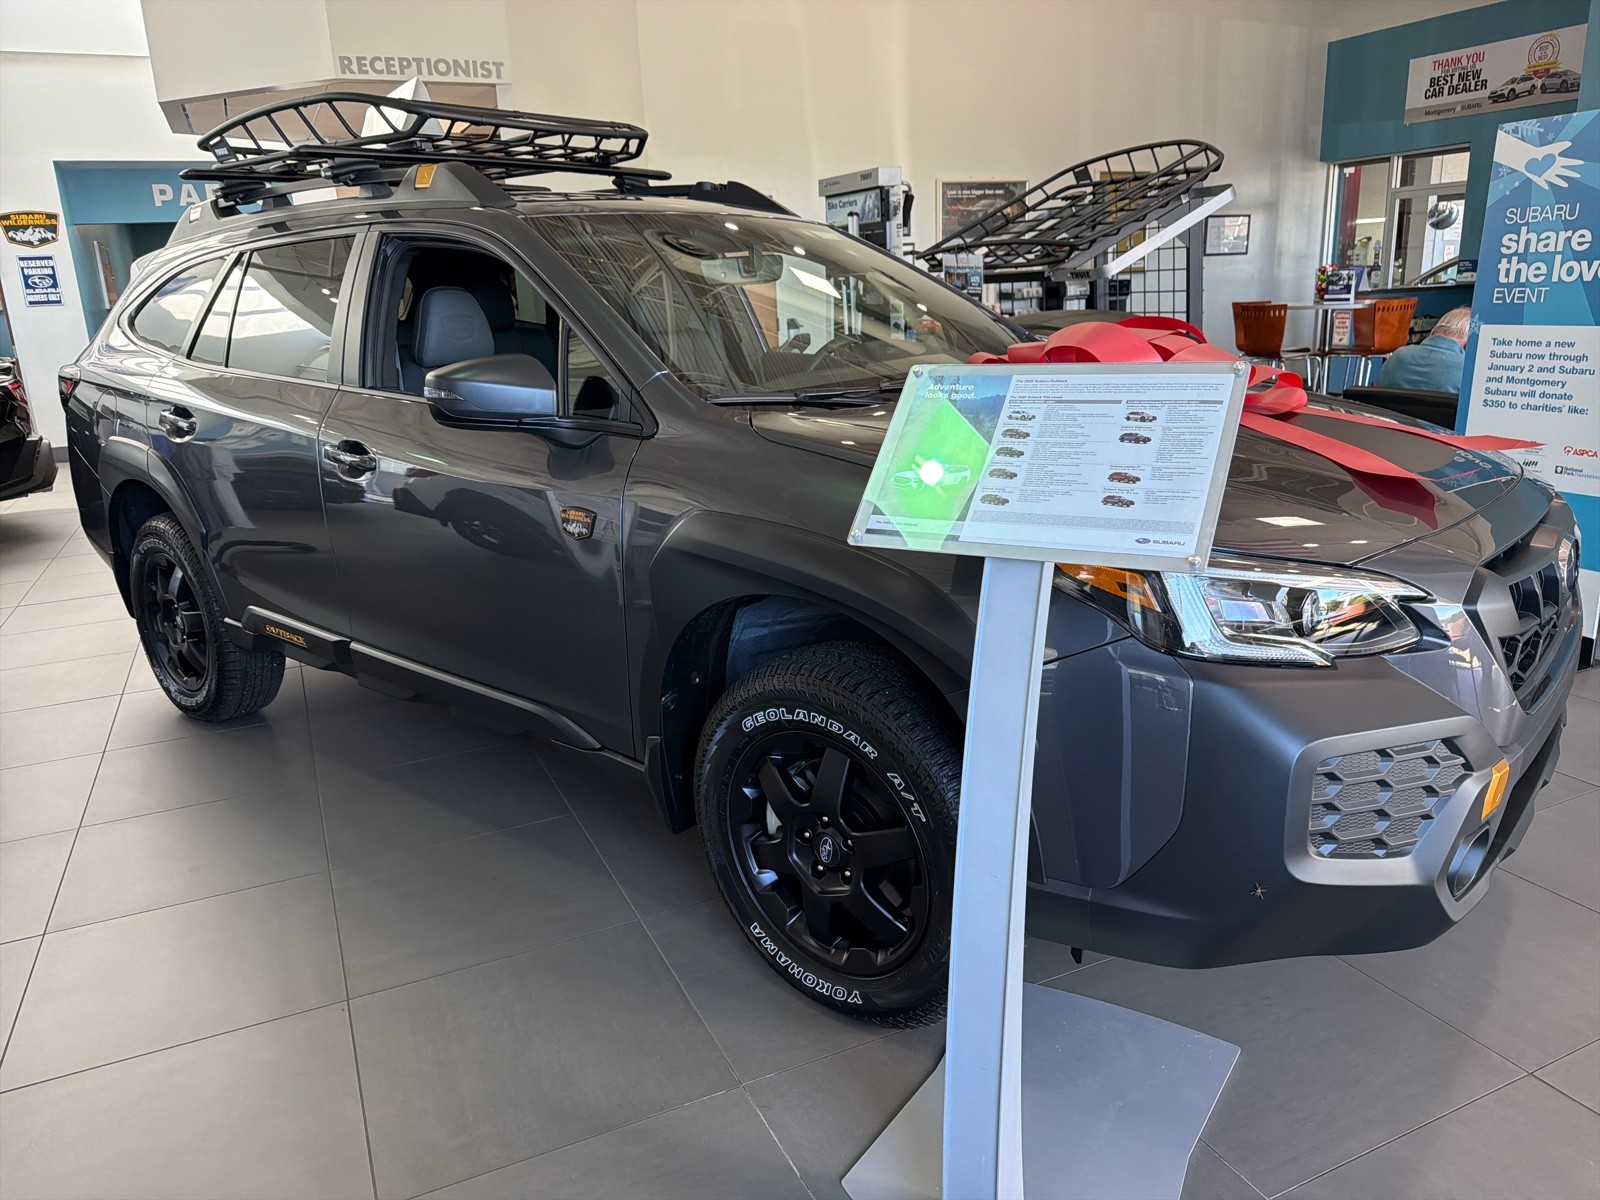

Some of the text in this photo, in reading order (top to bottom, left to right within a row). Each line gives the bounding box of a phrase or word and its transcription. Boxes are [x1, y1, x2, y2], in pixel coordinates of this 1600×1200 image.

[338, 55, 504, 79] RECEPTIONIST
[1432, 51, 1485, 71] THANK YOU
[1452, 65, 1468, 73] VOTING
[1429, 68, 1482, 88] BEST NEW
[1424, 79, 1488, 100] CAR DEALER
[1424, 107, 1457, 116] Montgomery
[1460, 102, 1482, 111] SUBARU
[828, 199, 857, 210] Bike Carriers
[1505, 203, 1580, 224] SUBARU
[1500, 226, 1592, 254] share
[20, 260, 54, 268] RESERVED
[24, 267, 53, 275] PARKING
[1498, 254, 1600, 284] the lov
[1492, 287, 1550, 304] EVENT
[1492, 338, 1513, 346] Take
[1516, 338, 1542, 347] home
[1490, 350, 1522, 359] Subaru
[1549, 352, 1588, 363] through
[1488, 363, 1525, 374] January
[1558, 366, 1595, 375] Subaru
[1506, 376, 1567, 389] Montgomery
[950, 392, 976, 400] good.
[1484, 387, 1573, 401] Subaru will donate
[1482, 399, 1506, 408] $350
[1509, 401, 1517, 409] to
[1568, 405, 1589, 415] like:
[1573, 448, 1598, 458] ASPCA
[265, 624, 305, 644] OUTBACK
[742, 708, 926, 822] GEOLANDAR A/T
[750, 922, 862, 1005] YOKOHAMA
